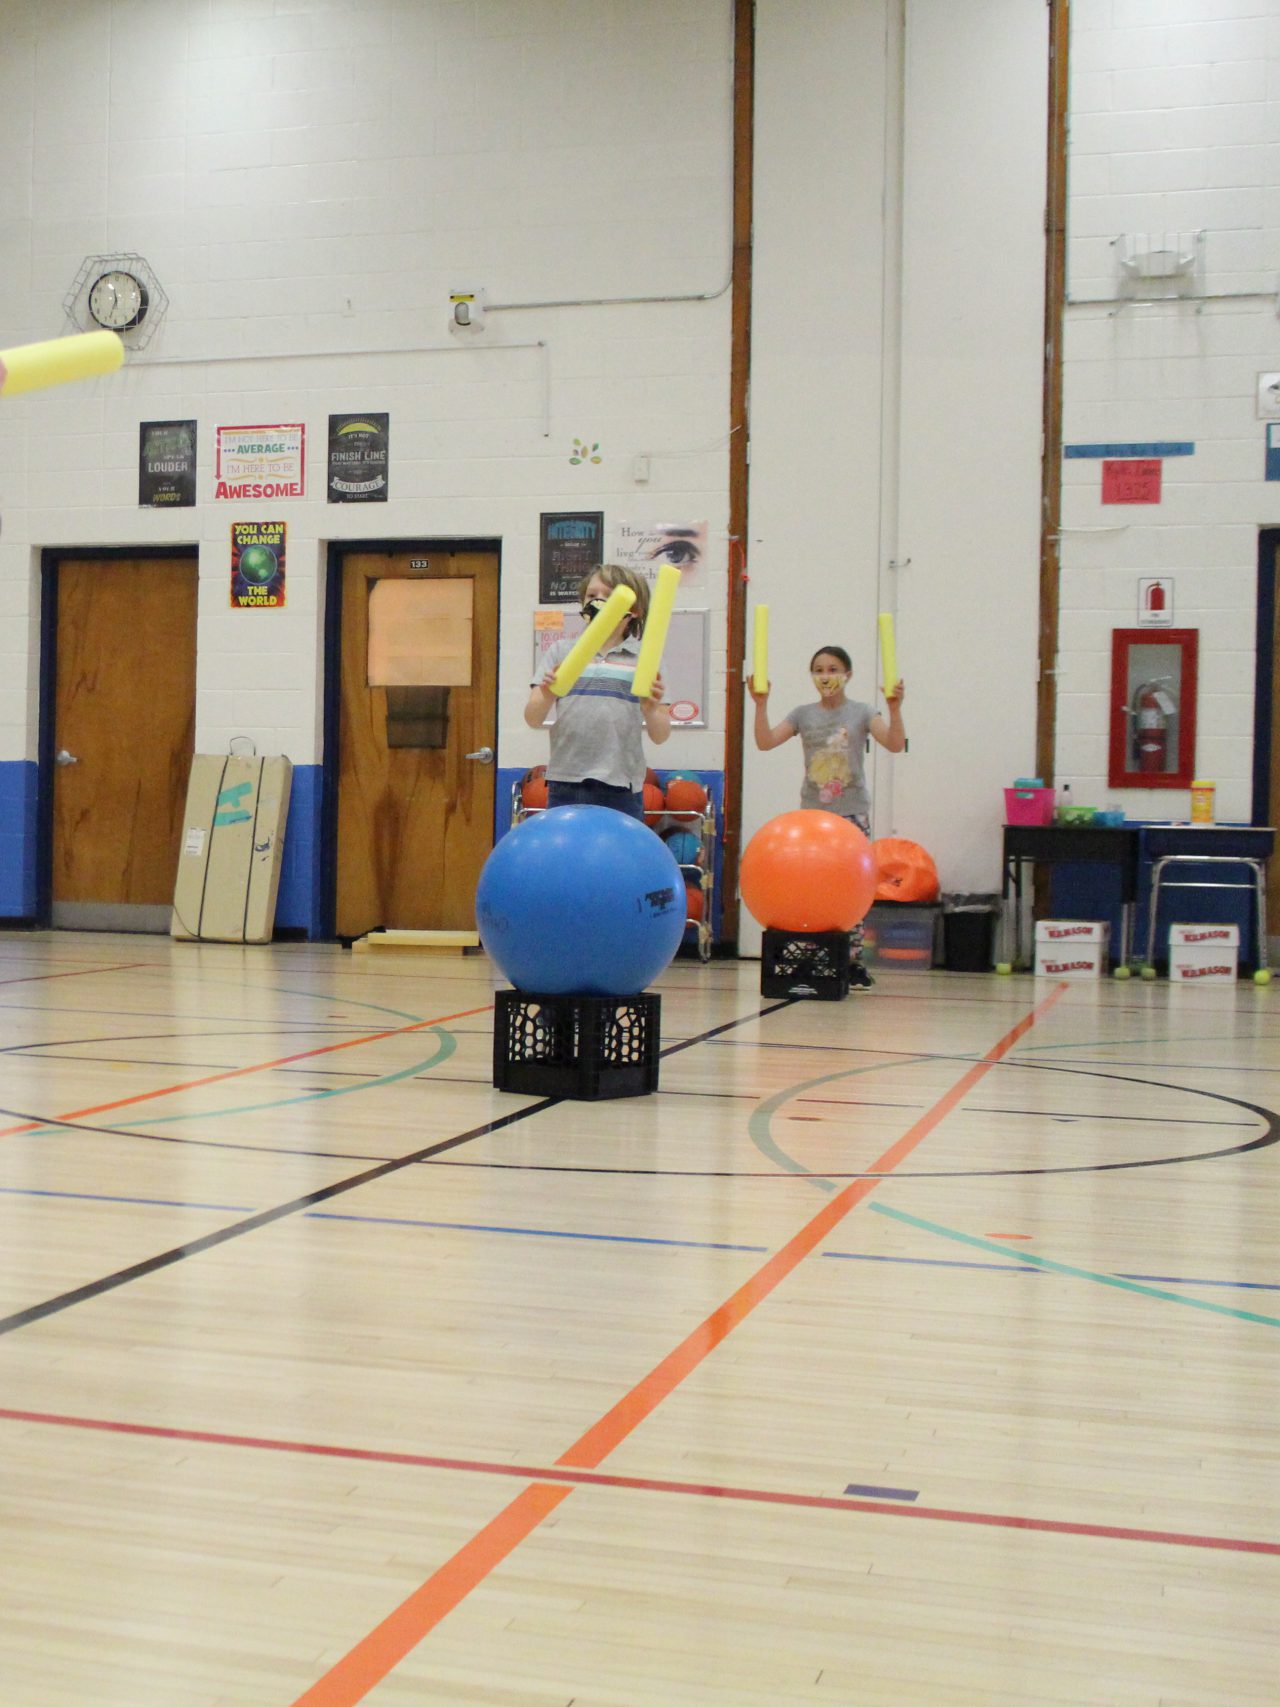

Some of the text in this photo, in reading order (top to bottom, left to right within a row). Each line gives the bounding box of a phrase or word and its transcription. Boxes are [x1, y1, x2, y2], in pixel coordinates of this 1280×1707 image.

[237, 443, 286, 454] AVERAGE
[331, 450, 386, 461] FINISH LINE
[148, 461, 188, 473] LOUDER
[226, 462, 295, 473] I'M HERE TO BE
[215, 481, 299, 499] AWESOME
[335, 480, 382, 492] COURAGE
[235, 524, 284, 535] YOU CAN
[621, 527, 645, 537] How
[237, 535, 280, 544] CHANGE
[635, 537, 662, 553] you
[411, 560, 427, 568] 133
[247, 586, 268, 595] THE
[238, 595, 277, 606] WORLD
